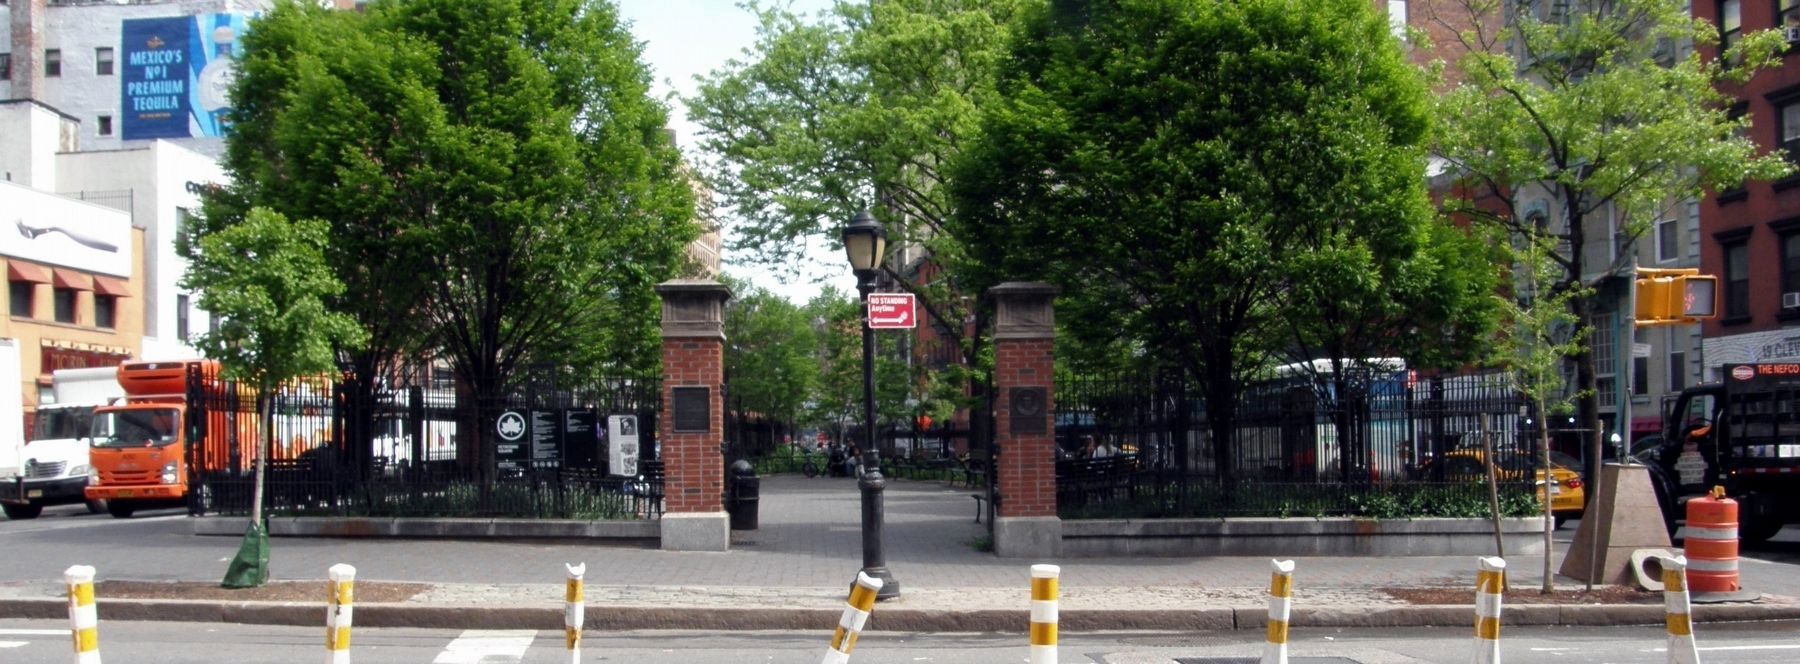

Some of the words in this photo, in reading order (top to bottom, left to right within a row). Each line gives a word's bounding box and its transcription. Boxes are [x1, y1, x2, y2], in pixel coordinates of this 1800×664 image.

[130, 50, 183, 65] MEXICO'S
[128, 80, 184, 96] PREMIUM
[133, 95, 179, 111] TEQUILA
[871, 304, 895, 313] Anytime
[1758, 364, 1773, 375] THE
[1774, 364, 1799, 375] NEFCO
